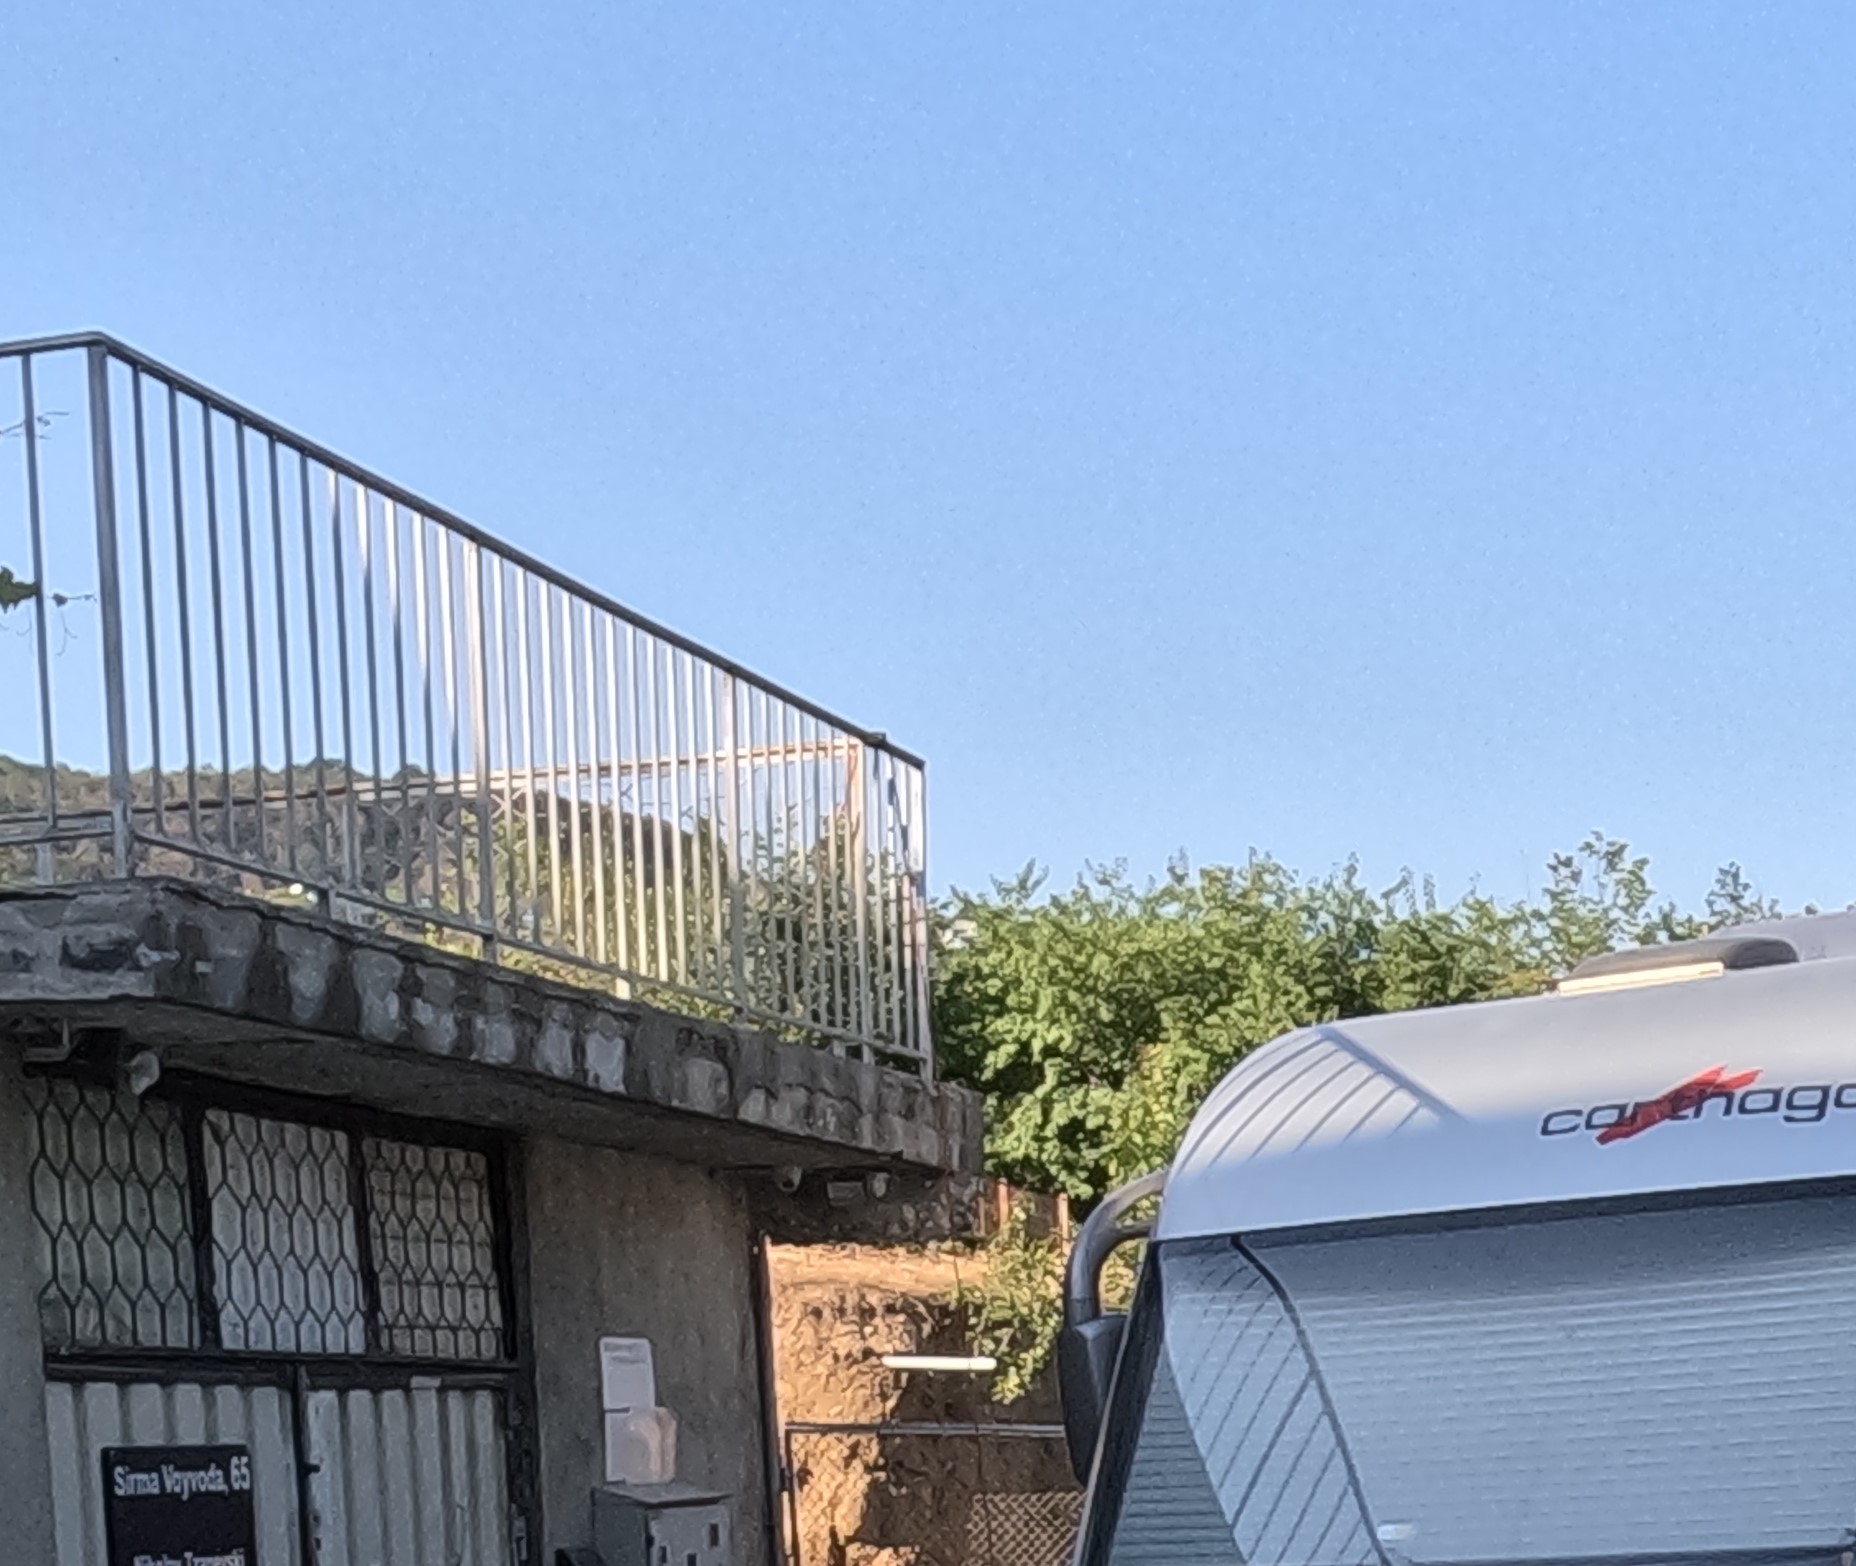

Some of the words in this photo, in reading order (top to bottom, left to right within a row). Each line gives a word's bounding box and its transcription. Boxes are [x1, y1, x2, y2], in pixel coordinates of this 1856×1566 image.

[114, 1465, 160, 1496] Sirma
[161, 1463, 229, 1501] Voyvoda,
[230, 1456, 250, 1490] 65
